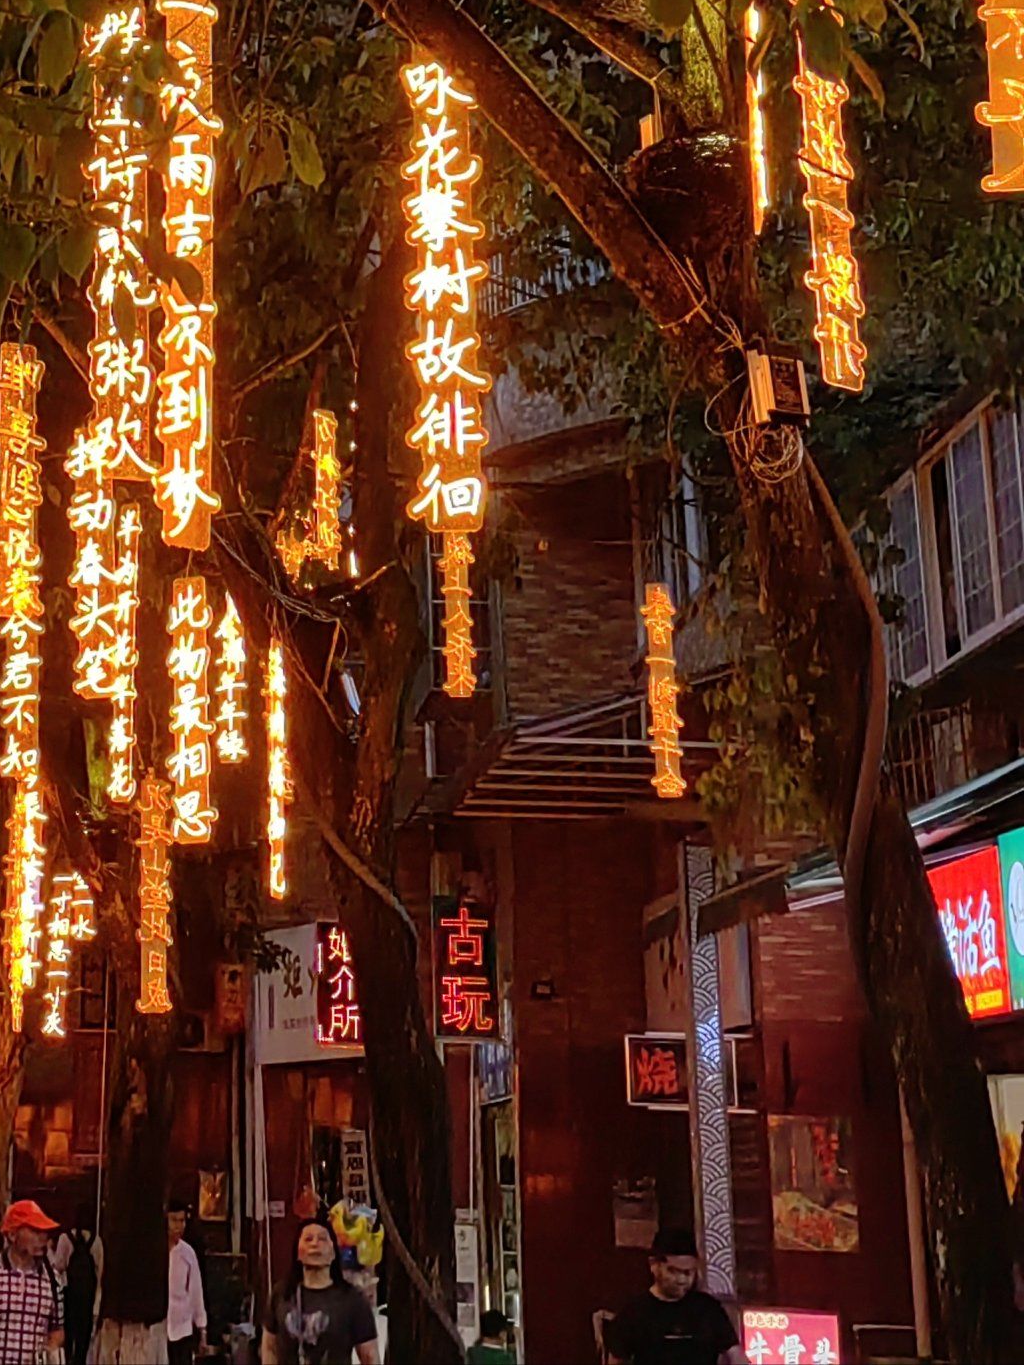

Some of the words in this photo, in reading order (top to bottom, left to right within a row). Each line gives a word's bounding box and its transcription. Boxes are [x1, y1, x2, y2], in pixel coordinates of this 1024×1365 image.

[404, 62, 488, 525] 咏花攀树故徘徊
[168, 584, 217, 837] 此物最相思
[440, 907, 493, 1032] 古玩
